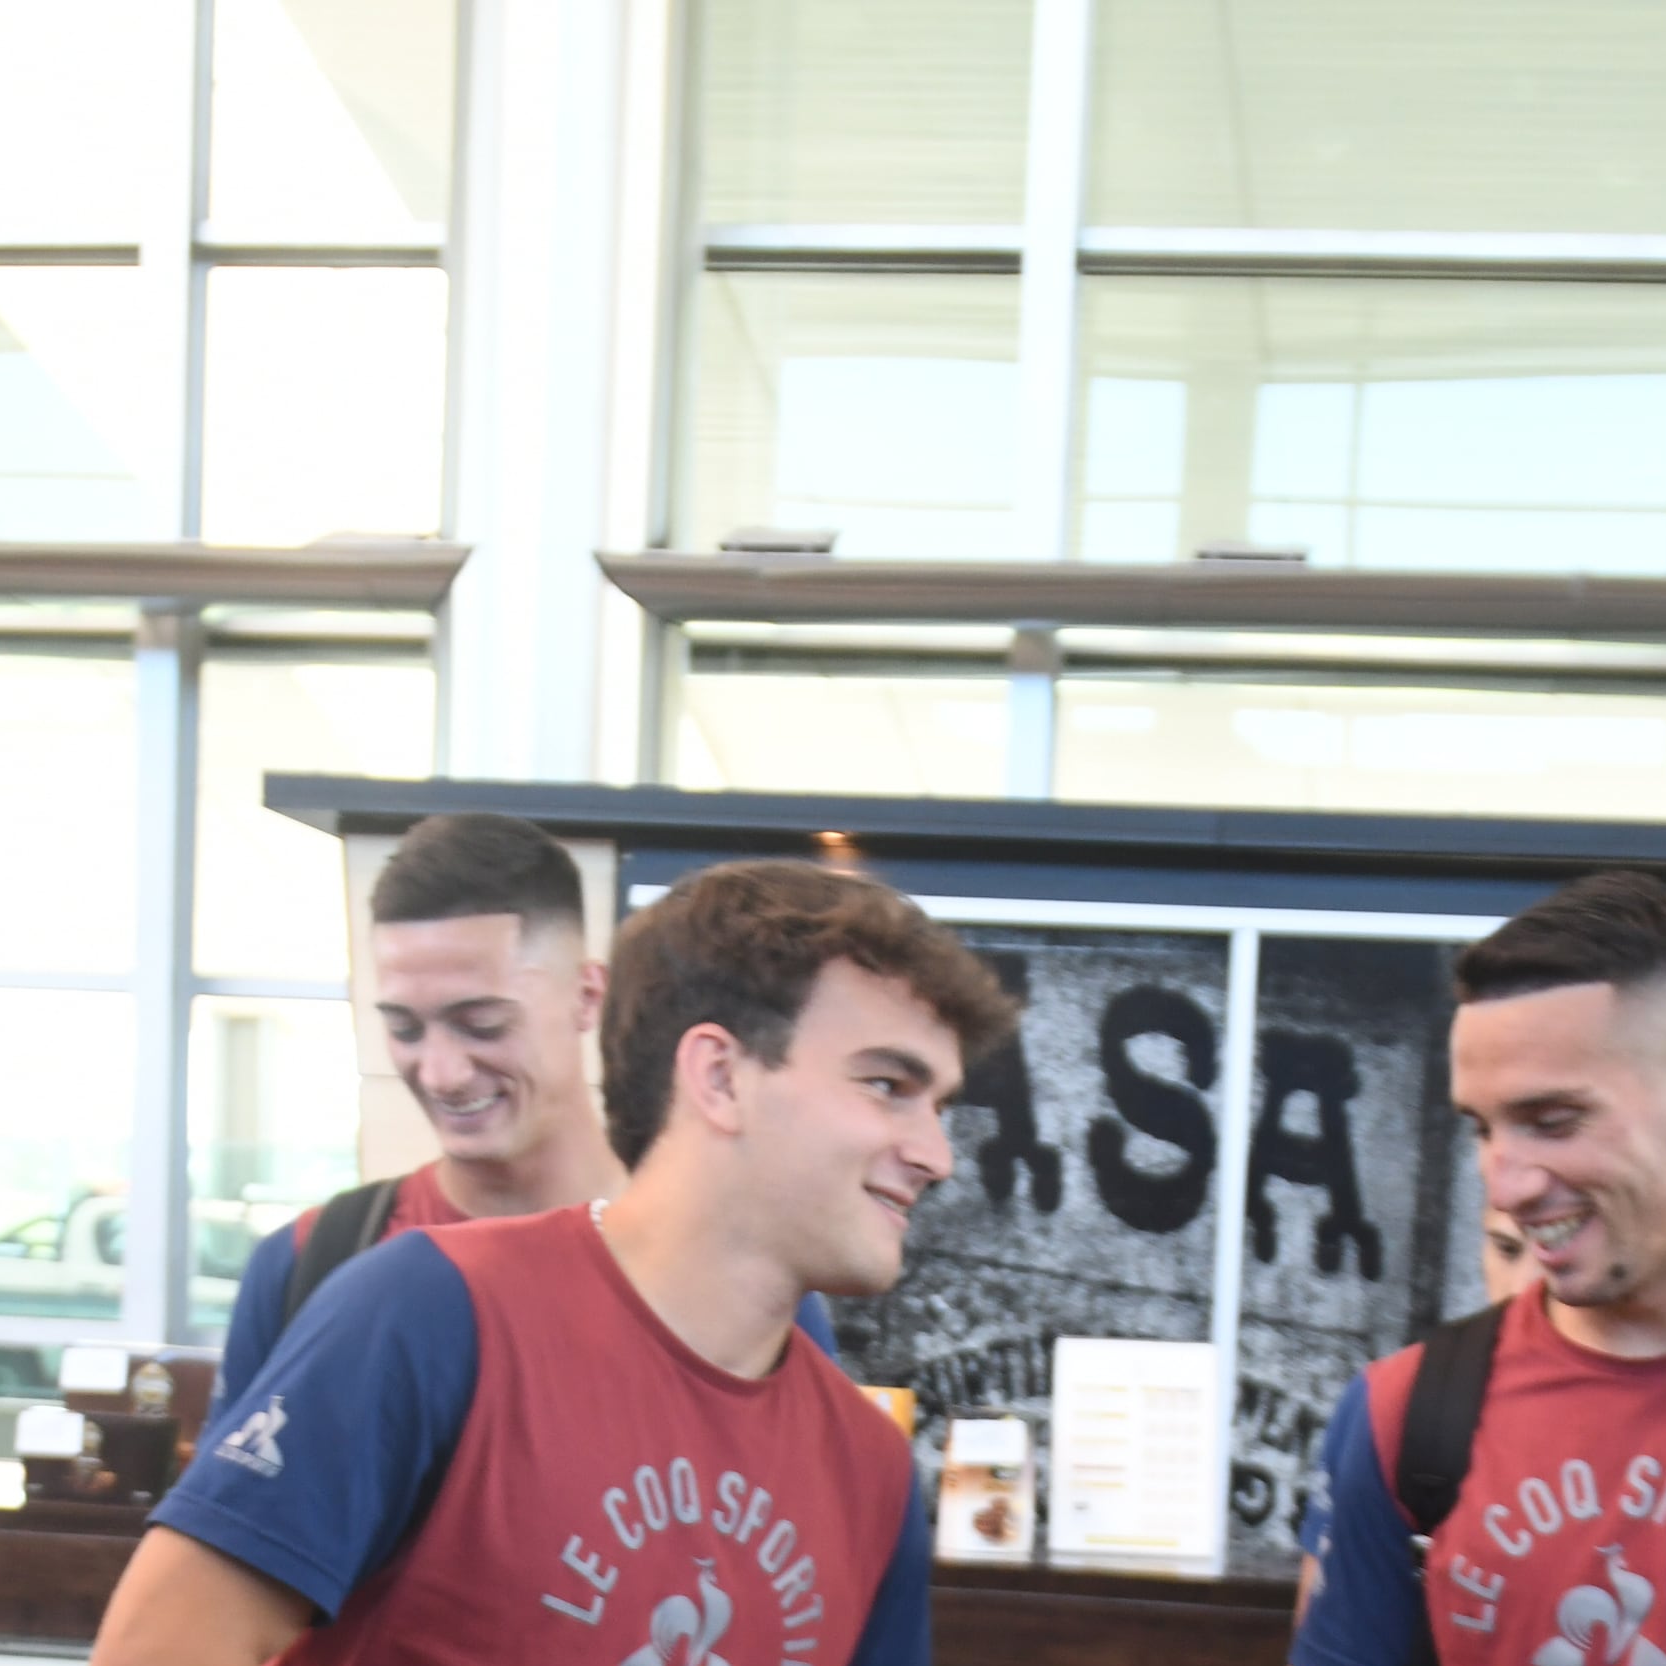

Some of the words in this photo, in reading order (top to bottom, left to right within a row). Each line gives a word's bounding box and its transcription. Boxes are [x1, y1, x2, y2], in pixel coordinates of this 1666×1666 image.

[541, 1534, 619, 1626] LE
[601, 1457, 702, 1550] COQ
[1448, 1553, 1506, 1633] LE
[1483, 1458, 1603, 1557] COQ
